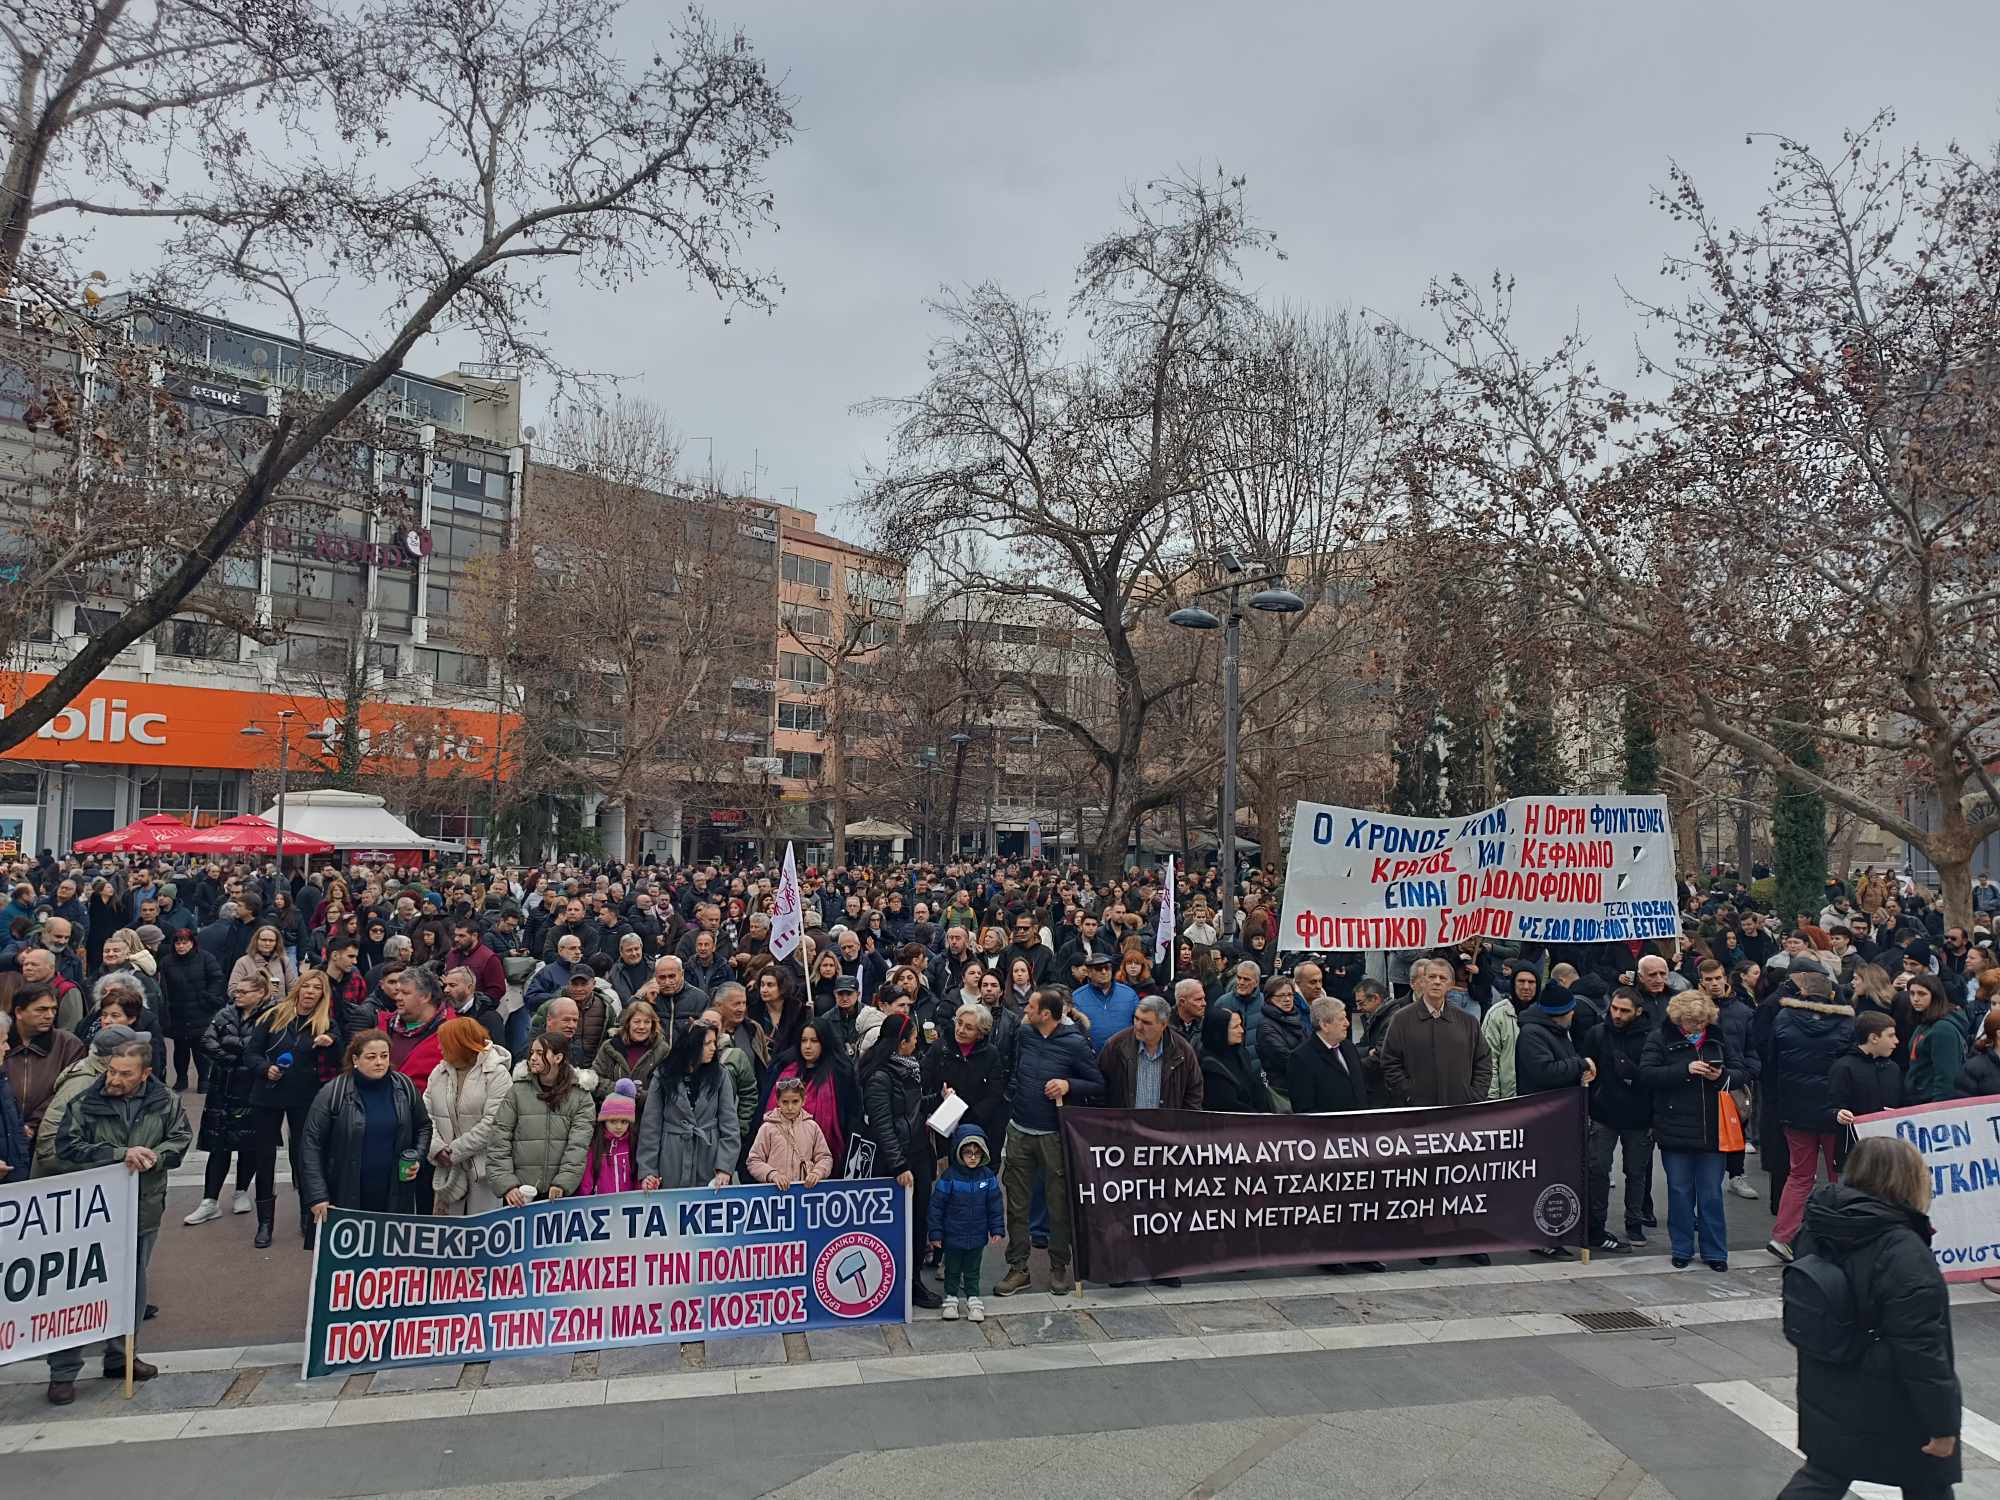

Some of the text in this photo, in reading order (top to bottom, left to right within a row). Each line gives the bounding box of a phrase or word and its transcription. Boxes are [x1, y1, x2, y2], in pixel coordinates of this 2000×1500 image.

[0, 697, 168, 745] blic
[1313, 812, 1333, 845] Ο
[1344, 817, 1450, 853] ΧΡΟΝΟΣ
[1524, 804, 1540, 835] Η
[1545, 804, 1585, 835] ΟΡΓΗ
[1591, 804, 1665, 834] ΦΟΥΝΤΩΝΕΙ
[1371, 838, 1613, 884] ΚΡΑΤΟΣ ΚΑΙ ΚΕΦΑΛΑΙΟ
[1385, 867, 1604, 909] ΕΙΝΑΙ ΟΙ ΔΟΛΟΦΟΝΟΙ
[1296, 910, 1427, 949] ΦΟΙΤΗΤΙΚΟΙ
[1089, 1128, 1525, 1168] ΤΟ ΕΓΚΛΗΜΑ ΑΥΤΟ ΔΕΝ ΘΑ ΞΕΧΑΣΤΕΙ!
[1078, 1158, 1537, 1205] Η ΟΡΓΗ ΜΑΣ ΝΑ ΤΣΑΚΙΣΕΙ ΤΗΝ ΠΟΛΙΤΙΚΗ
[1930, 1157, 2000, 1199] ΓΚΛΗ
[330, 1188, 893, 1258] ΟΙ ΝΕΚΡΟΙ ΜΑΣ ΤΑ ΚΕΡΔΗ ΤΟΥΣ
[1133, 1193, 1488, 1236] ΠΟΥ ΔΕΝ ΜΕΤΡΑΕΙ ΤΗ ΖΩΗ ΜΑΣ
[329, 1241, 807, 1311] Η ΟΡΓΗ ΜΑΣ ΝΑ ΤΣΑΚΙΣΕΙ ΤΗΝ ΠΟΛΙΤΙΚΗ
[815, 1236, 855, 1311] ΕΡΓΑΤΟΥΠΑΛΛΗΛΙΚΟ
[857, 1235, 888, 1260] ΚΕΝΤΡΟ
[31, 1299, 108, 1343] ΤΡΑΠΕΖΩΝ)
[325, 1286, 807, 1365] ΠΟΥ ΜΕΤΡΑ ΤΗΝ ΖΩΗ ΜΑΣ ΩΣ ΚΟΣΤΟΣ
